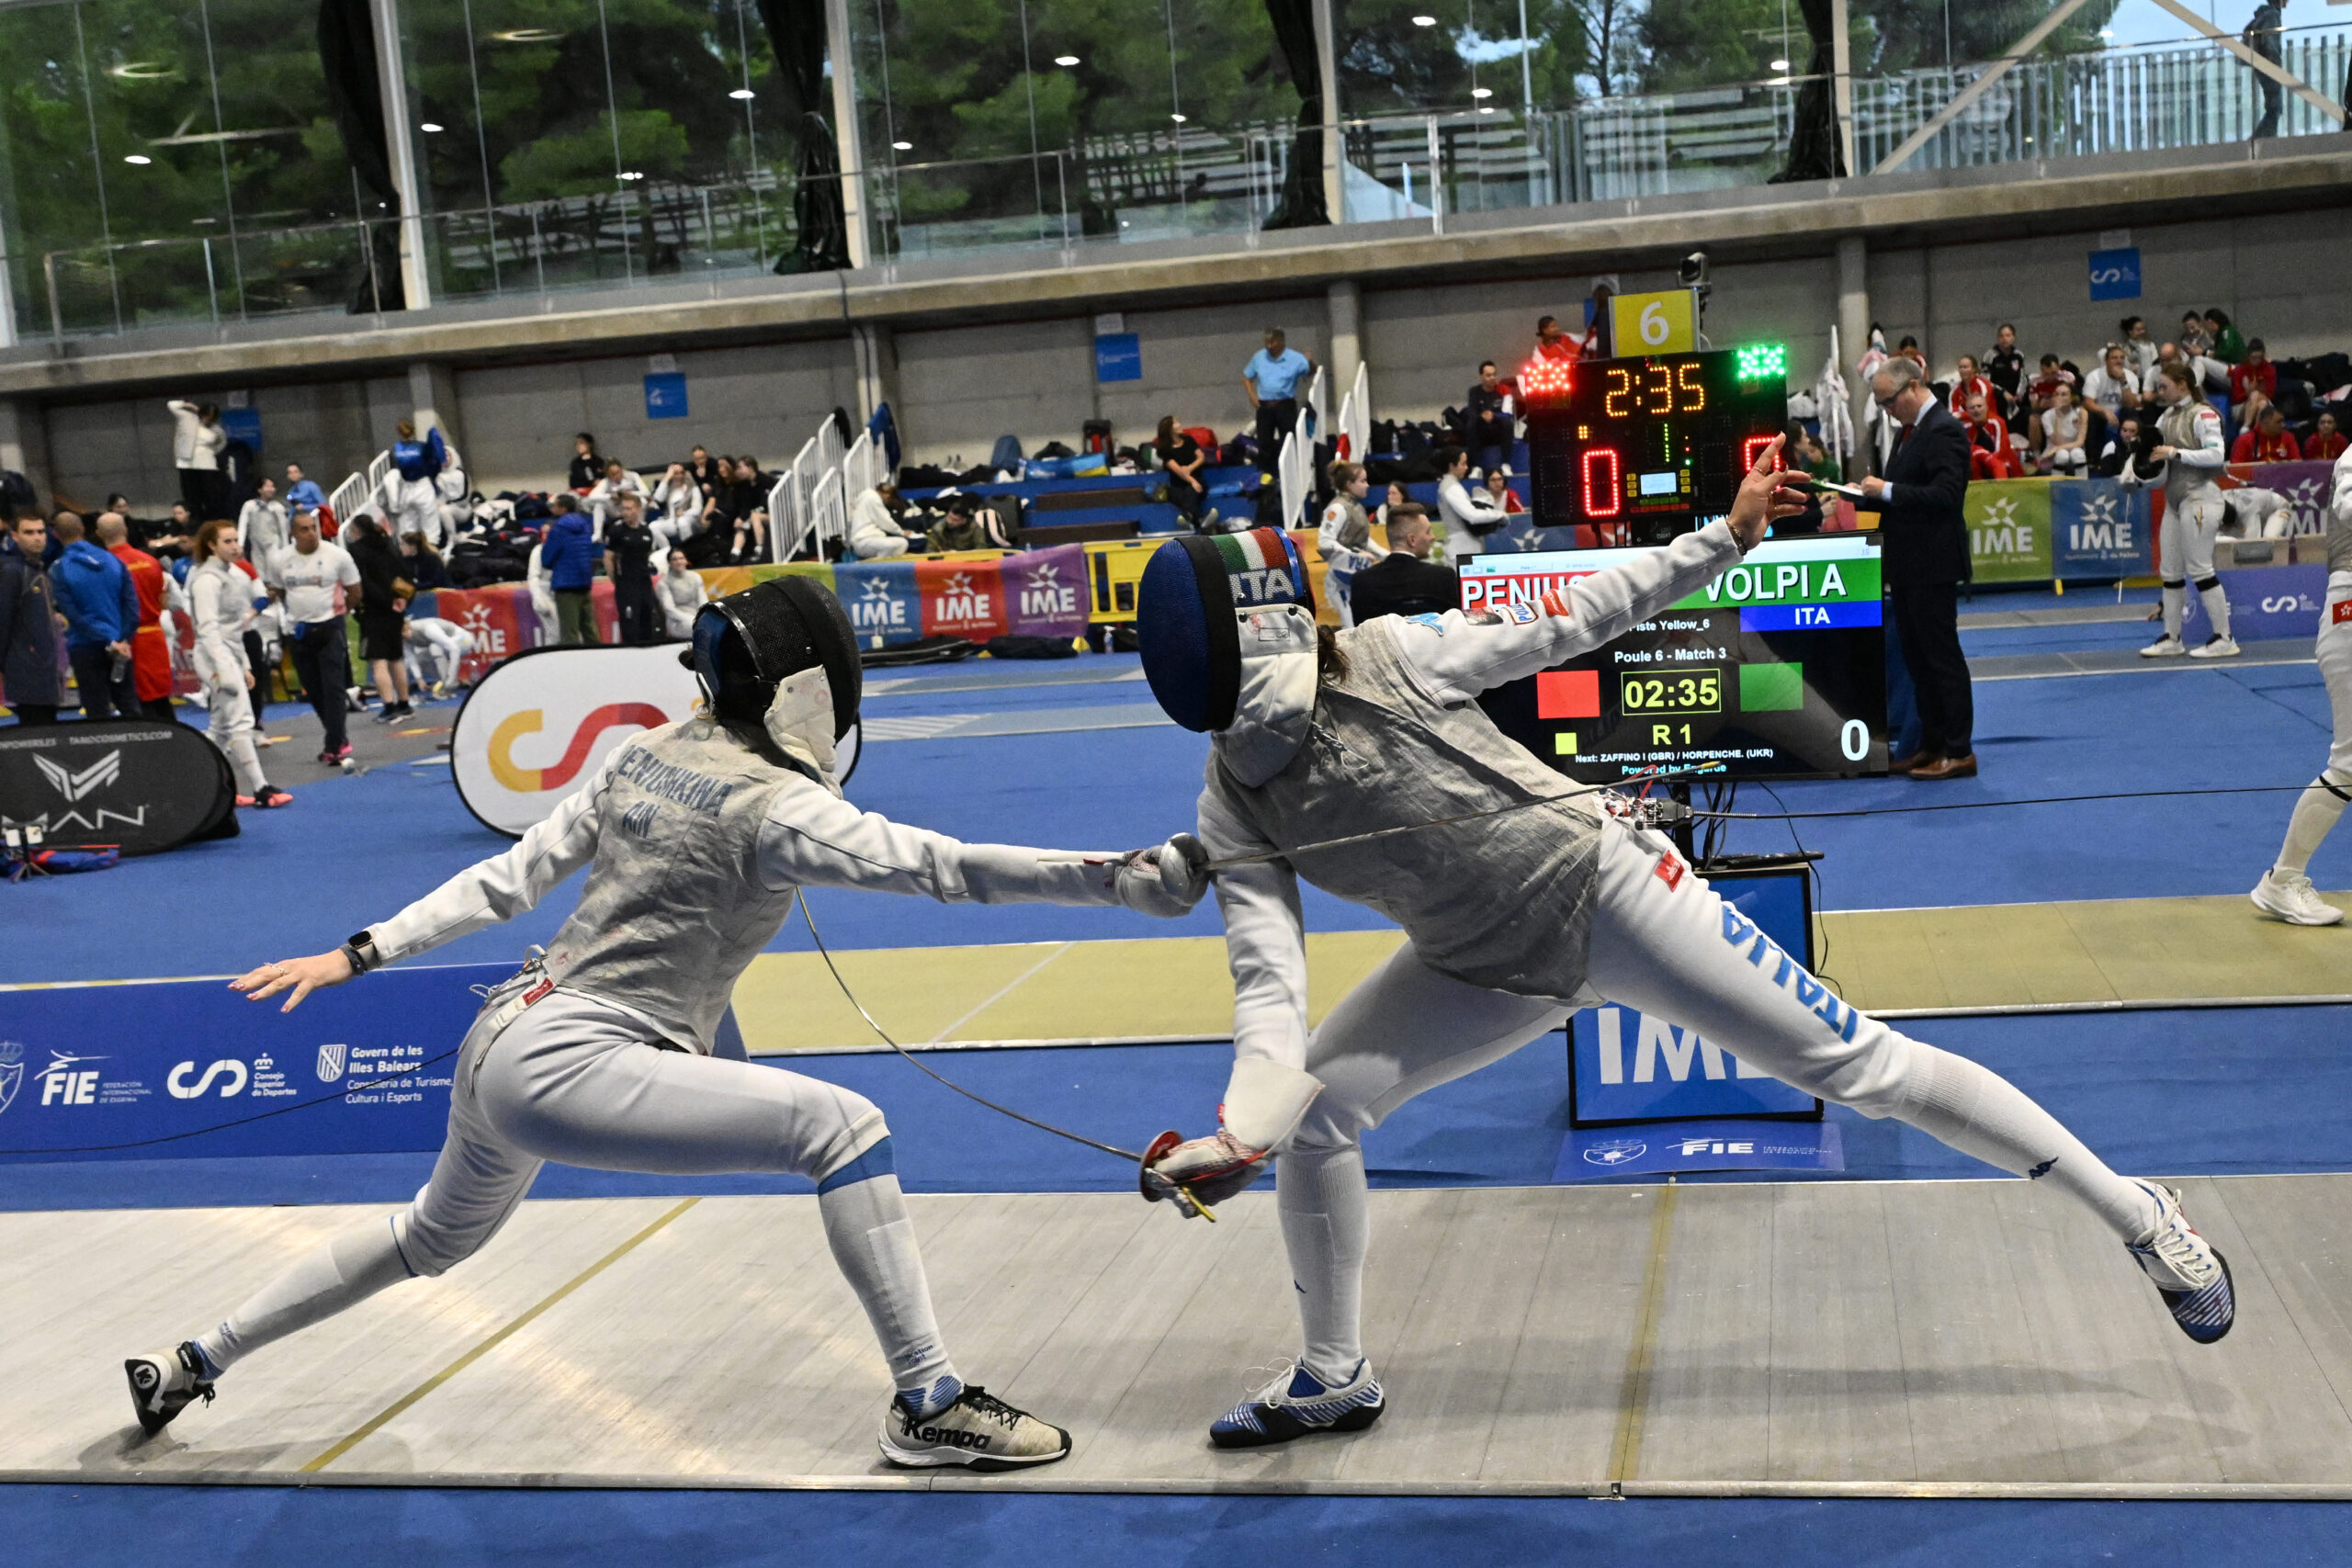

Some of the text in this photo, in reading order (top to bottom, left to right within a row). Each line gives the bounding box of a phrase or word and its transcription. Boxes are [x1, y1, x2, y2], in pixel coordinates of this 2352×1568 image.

[1640, 301, 1668, 345] 6
[1607, 364, 1704, 416] 2:35
[1583, 448, 1619, 516] 0
[1973, 526, 2033, 555] IME
[2070, 523, 2132, 550] IME
[1229, 569, 1296, 604] ITA
[1705, 563, 1848, 602] VOLPI A
[852, 600, 906, 626] IME
[935, 594, 990, 622] IME
[1021, 588, 1076, 615] IME
[1659, 619, 1710, 632] Yellow_6
[1794, 607, 1831, 626] ITA
[472, 629, 506, 654] ME
[1614, 650, 1654, 663] Poule
[1655, 649, 1664, 662] 6
[1675, 649, 1715, 661] Match
[1718, 648, 1727, 660] 3
[1624, 678, 1719, 708] 02:35
[1652, 724, 1691, 745] R 1
[1840, 719, 1870, 761] 0
[1575, 754, 1598, 762] Next:
[1600, 753, 1640, 762] ZAFFINO
[1647, 752, 1675, 762] (GBR)
[1682, 750, 1744, 761] HORPENCHE.
[1747, 749, 1774, 759] (UKR)
[618, 745, 733, 817] ENIUSHKINA
[351, 1044, 424, 1058] Govern de les
[254, 1072, 285, 1081] Consejo
[349, 1060, 423, 1073] Illes Balears
[41, 1071, 99, 1106] FIE
[254, 1080, 285, 1089] Superior
[264, 1089, 297, 1098] Deportes
[401, 1077, 413, 1088] de
[345, 1093, 379, 1104] Cultura
[387, 1092, 423, 1104] Esports
[1682, 1143, 1754, 1156] FIE
[903, 1417, 992, 1450] Kempa
